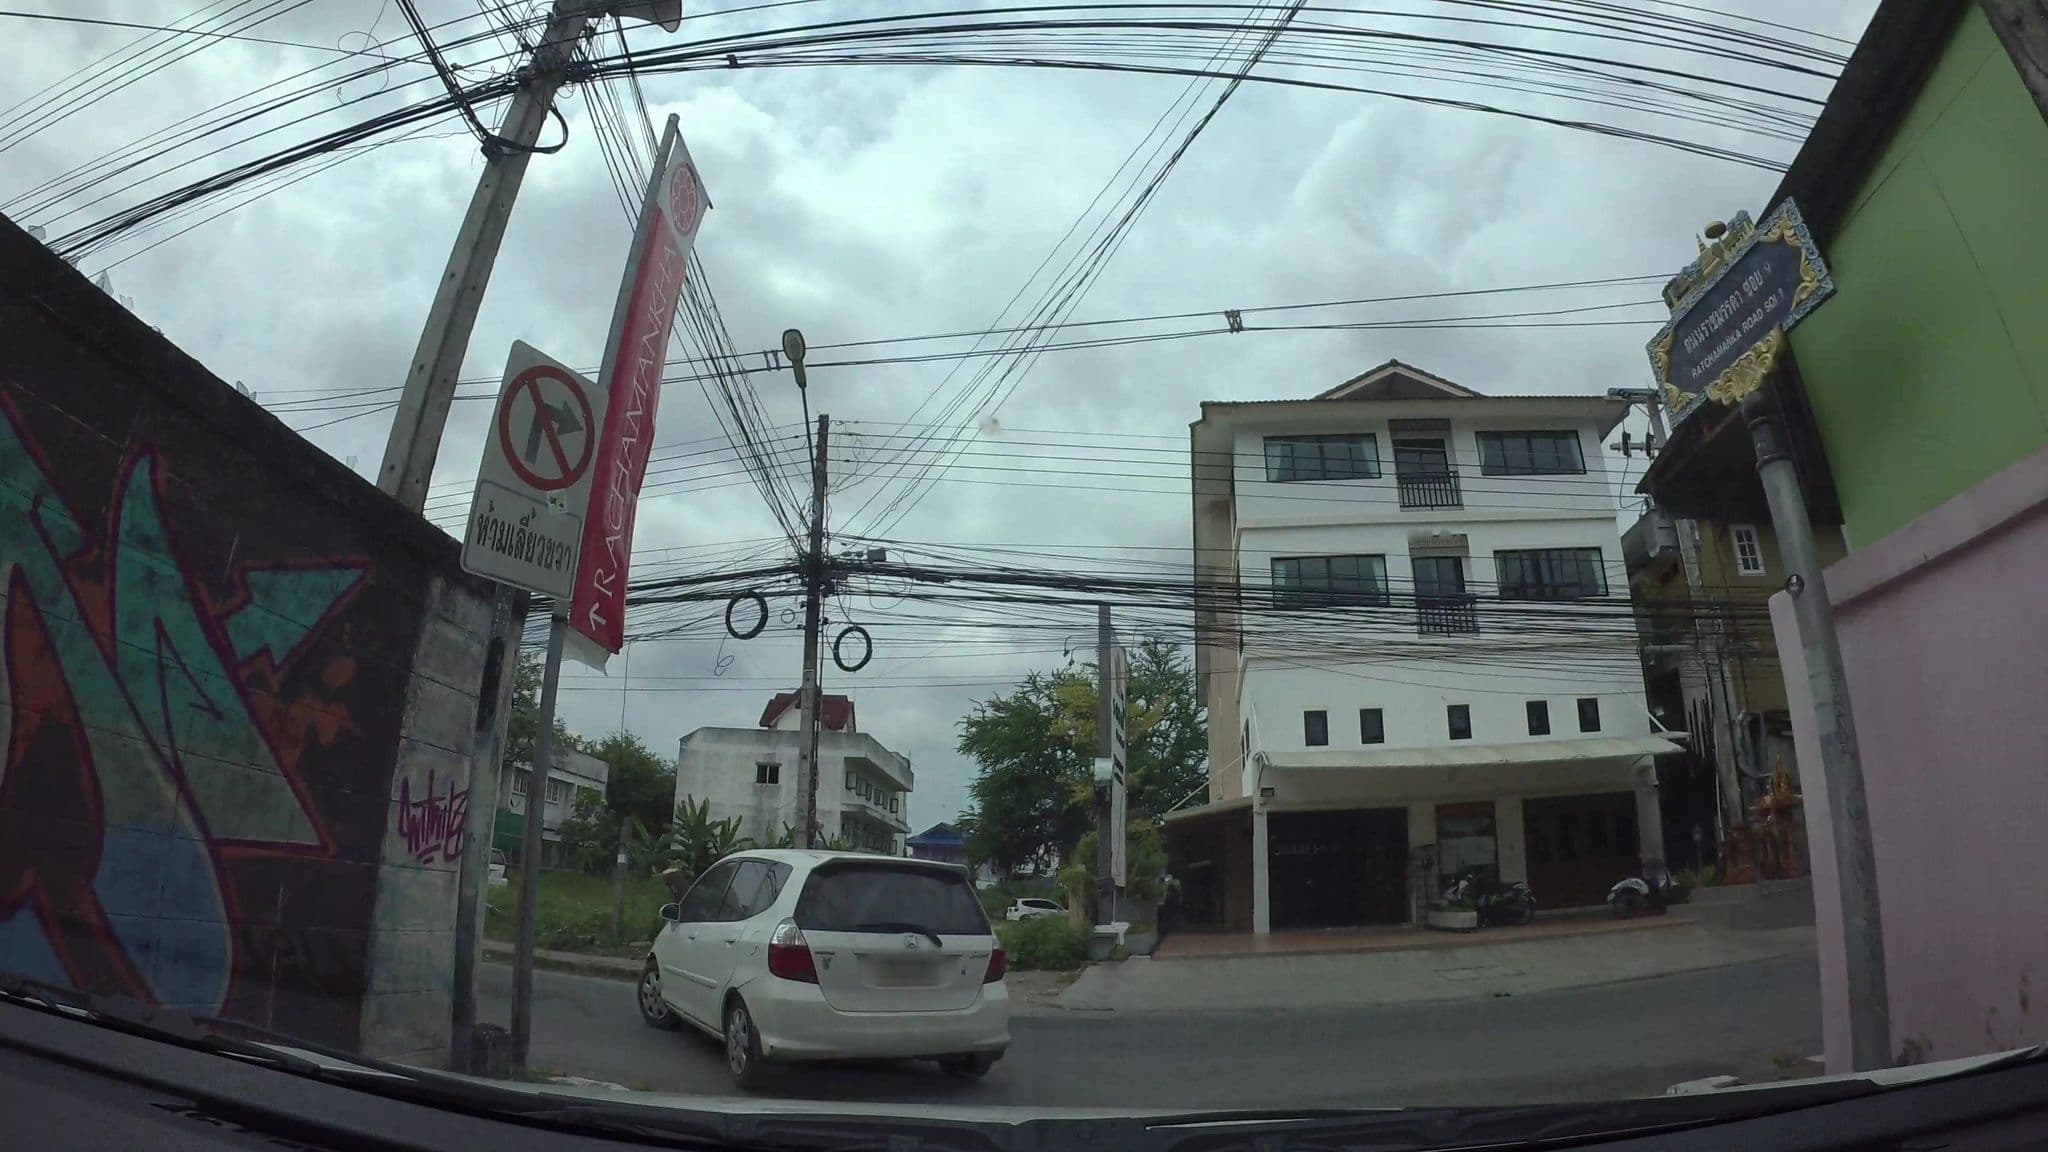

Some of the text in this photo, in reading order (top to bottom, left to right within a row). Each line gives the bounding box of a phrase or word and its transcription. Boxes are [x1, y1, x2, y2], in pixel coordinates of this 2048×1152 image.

[1743, 269, 1764, 297] ซอย
[1742, 308, 1764, 333] ROAD
[1764, 294, 1777, 313] SOI
[593, 246, 675, 598] RACHAMANKHA
[476, 500, 572, 573] ห้ามเลี้ยวขวา
